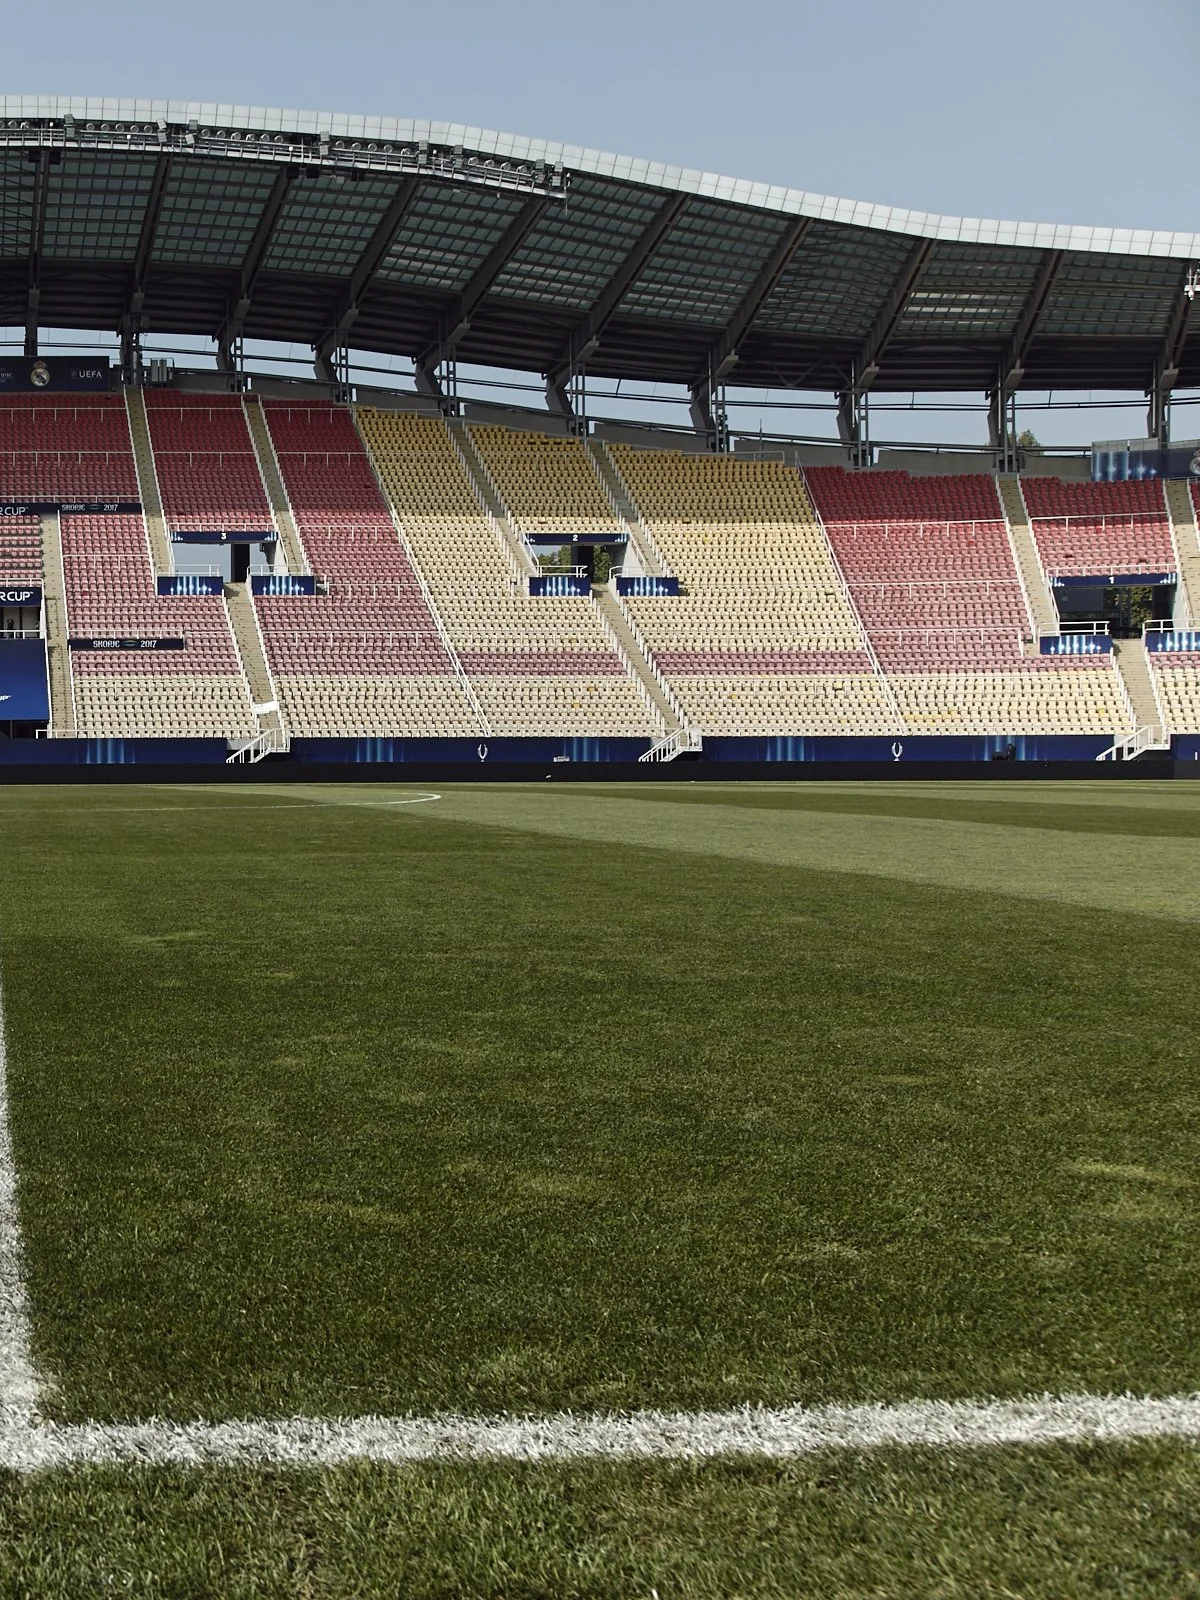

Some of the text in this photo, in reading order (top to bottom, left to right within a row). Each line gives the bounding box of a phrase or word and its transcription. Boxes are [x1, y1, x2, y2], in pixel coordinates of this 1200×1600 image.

[79, 370, 102, 378] UEFA
[4, 506, 26, 516] CUP
[1109, 576, 1115, 584] 1
[6, 591, 30, 601] CUP
[92, 640, 158, 648] SKOPJE 2017
